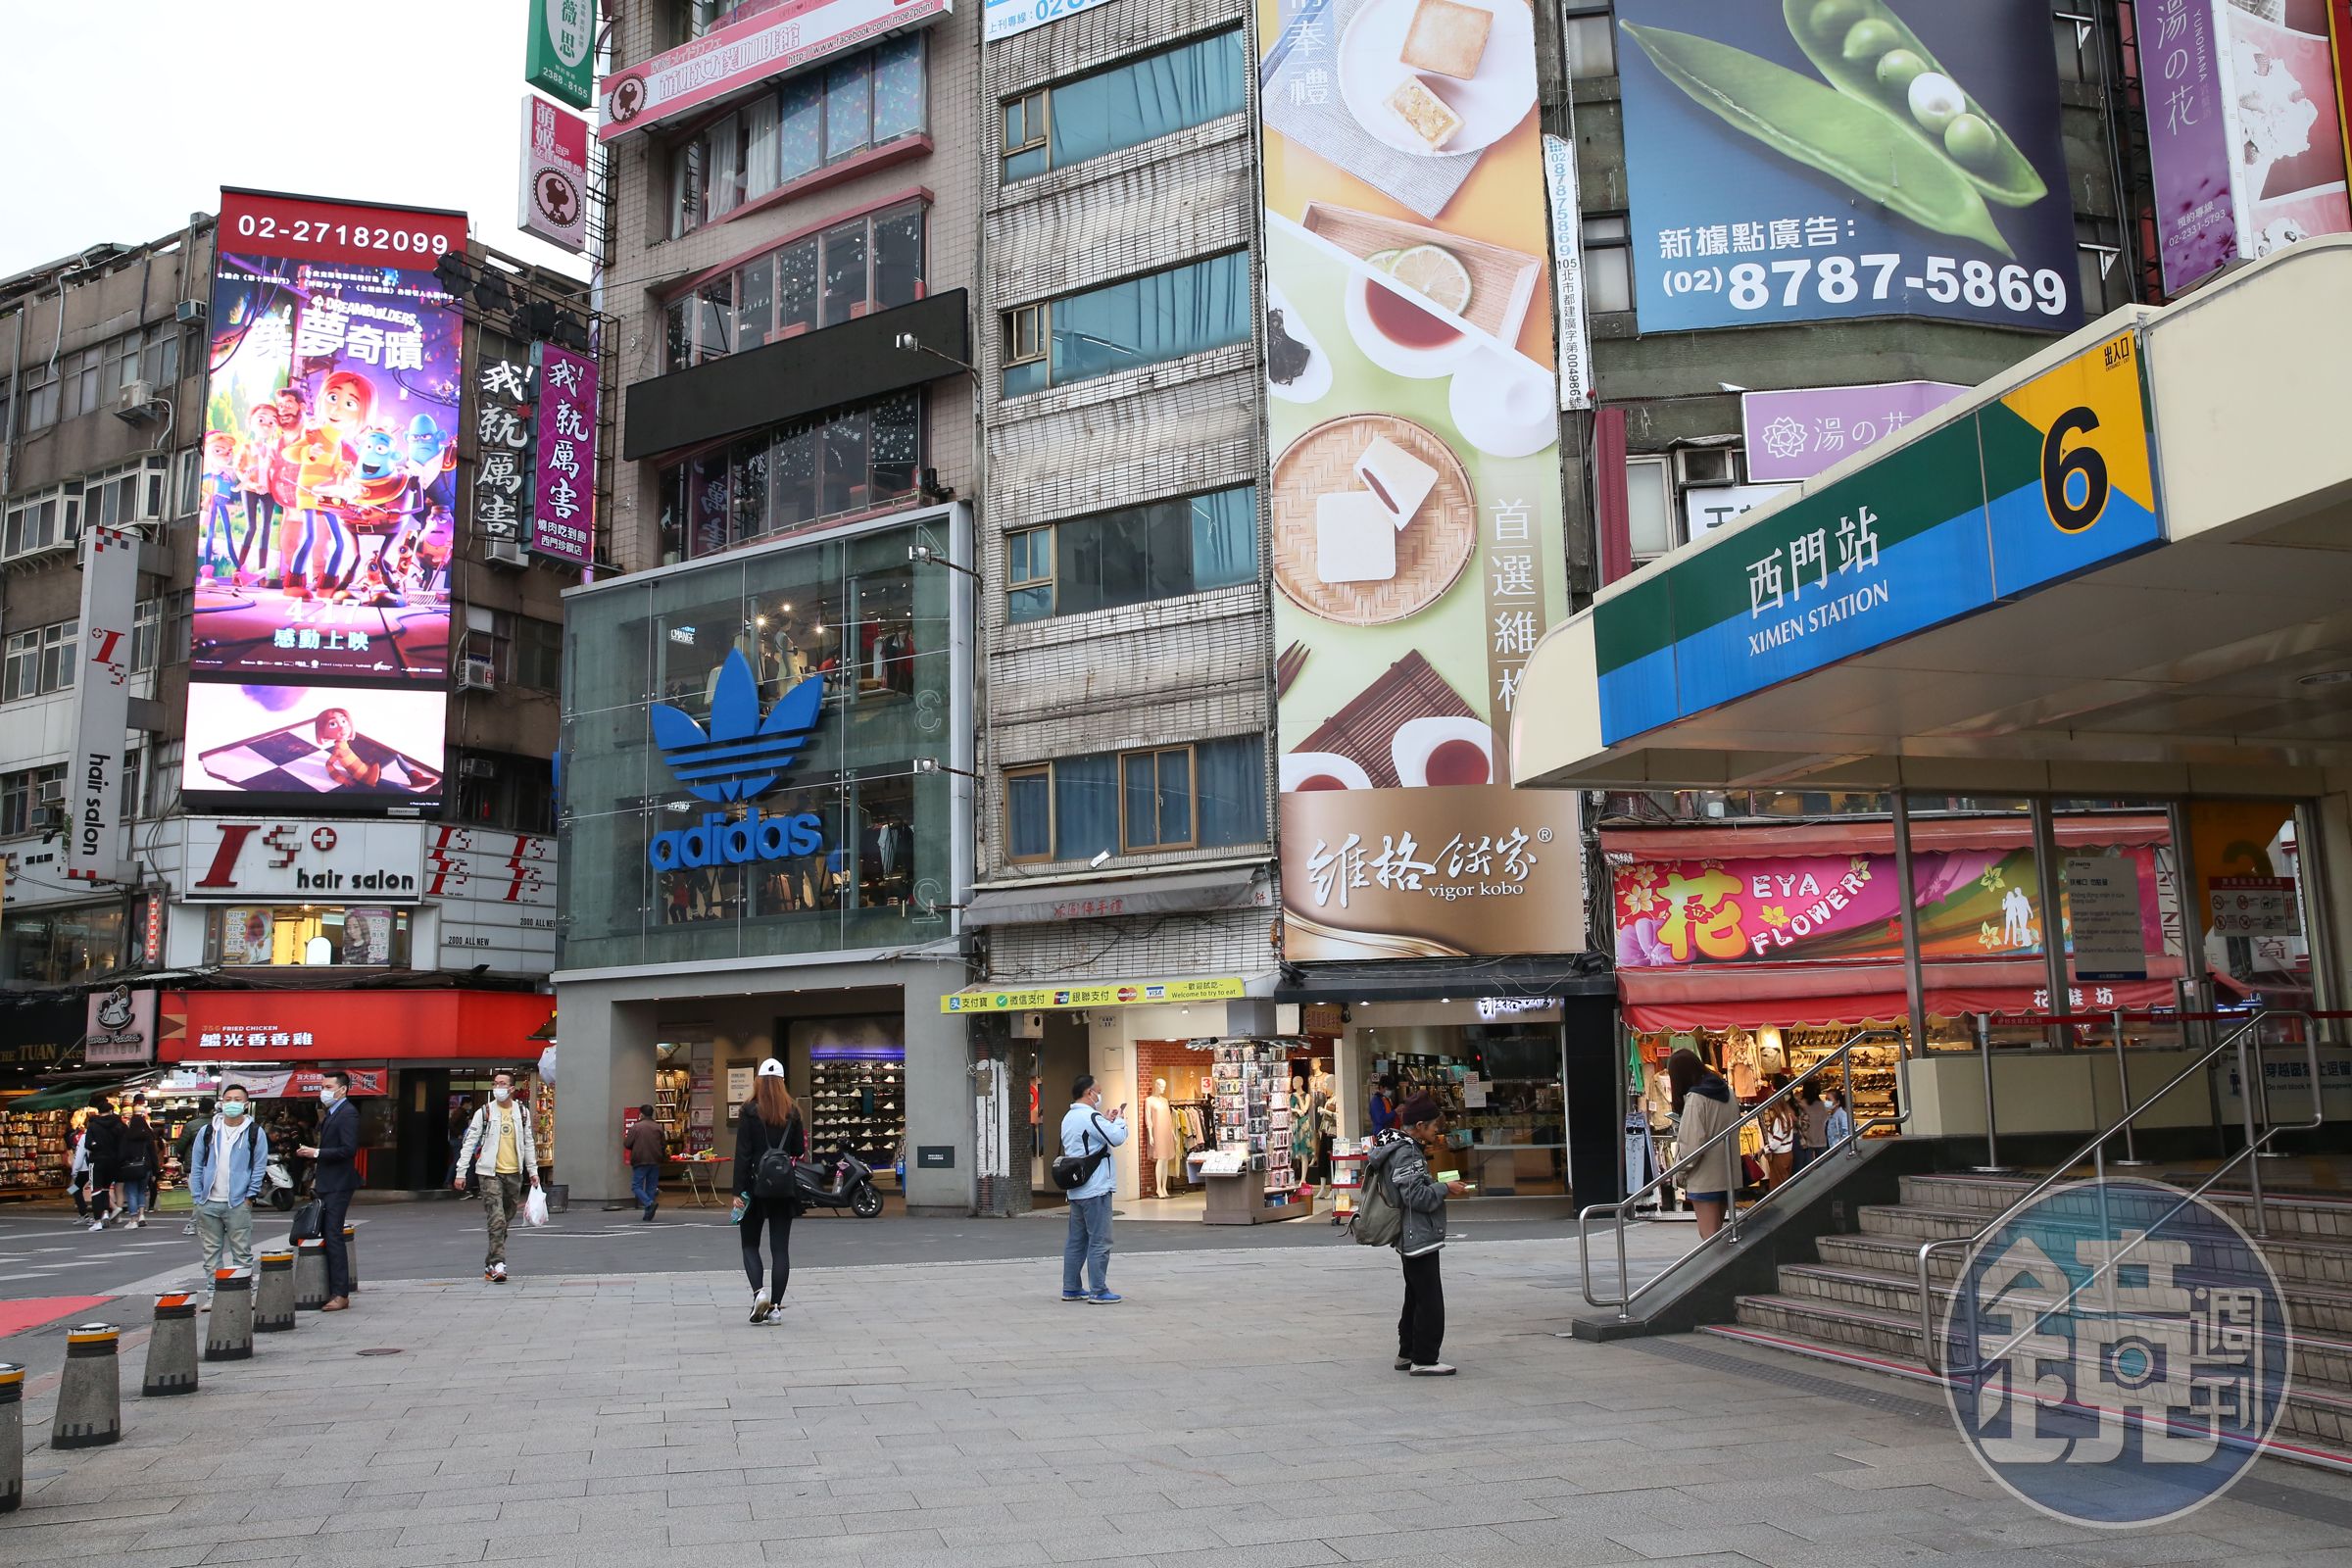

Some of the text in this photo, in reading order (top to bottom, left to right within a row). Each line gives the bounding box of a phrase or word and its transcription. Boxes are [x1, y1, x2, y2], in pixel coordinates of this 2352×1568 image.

[2193, 8, 2208, 82] YUNOHANA
[543, 67, 588, 98] 2388-8155
[238, 214, 449, 256] 02-27182099
[2169, 209, 2226, 247] 02-2331-5793
[2104, 336, 2130, 368] 出入口
[2043, 406, 2108, 531] 6
[1746, 505, 1880, 620] 西門站
[285, 596, 362, 625] 4.17
[1748, 579, 1890, 658] XIMEN STATION
[273, 627, 369, 652] 感動上映
[82, 753, 111, 857] hair salon
[649, 808, 823, 872] adidas
[296, 868, 415, 891] hair salon
[1428, 881, 1524, 902] vigor kobo
[1751, 872, 1822, 899] EYA
[535, 919, 546, 928] ALL
[1656, 867, 1749, 961] 花
[1750, 871, 1866, 956] FLOWER
[448, 936, 490, 947] 2000 ALL NEW
[961, 997, 988, 1008] 支付寶
[1009, 994, 1046, 1005] 微信支付
[1072, 991, 1109, 1004] 銀聯支付
[18, 1044, 58, 1061] TUAN
[199, 1031, 314, 1048] 繼光香香雞
[1202, 1078, 1211, 1089] 3
